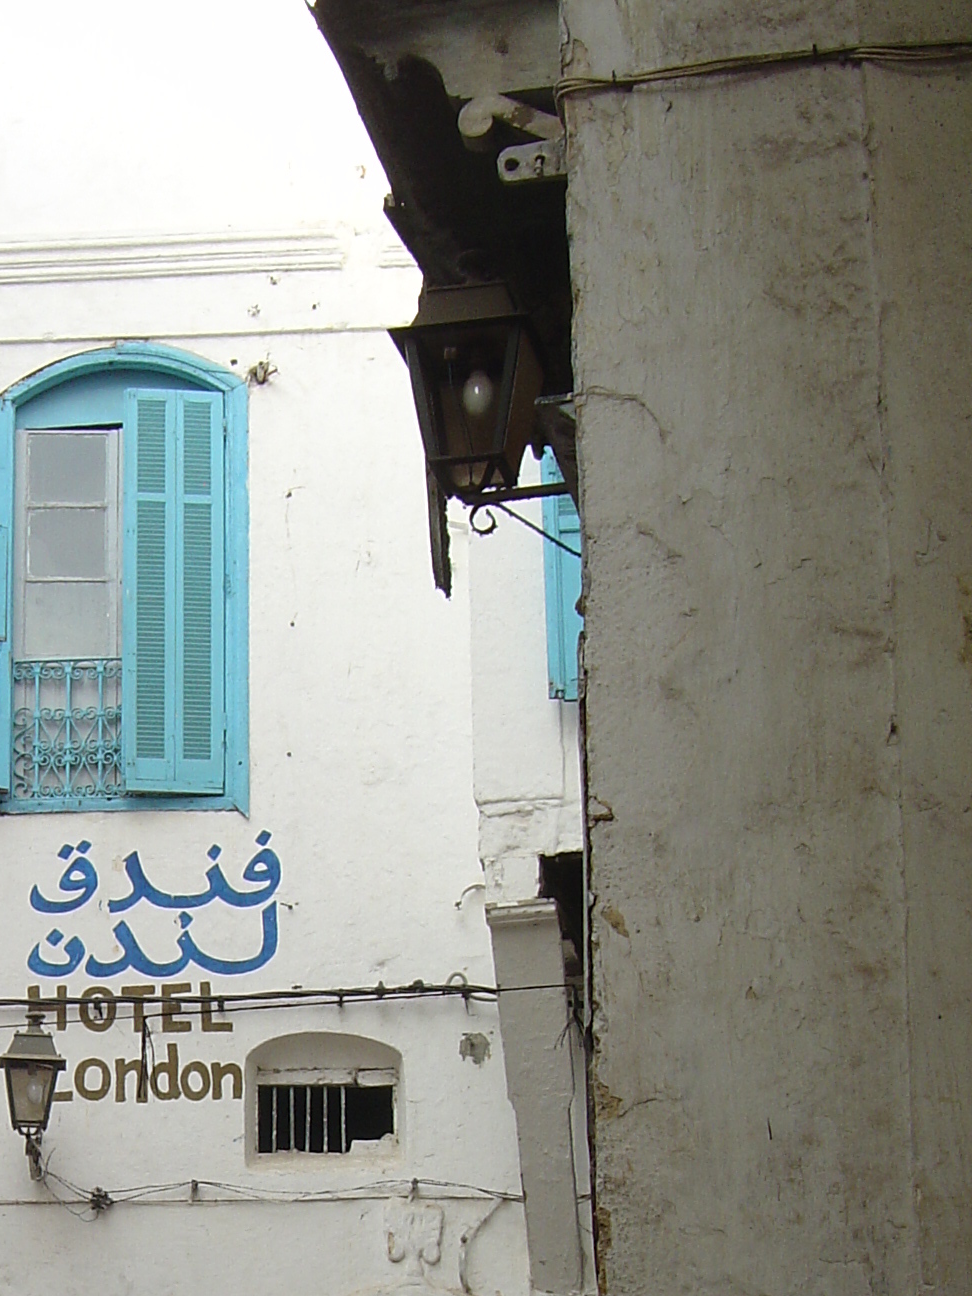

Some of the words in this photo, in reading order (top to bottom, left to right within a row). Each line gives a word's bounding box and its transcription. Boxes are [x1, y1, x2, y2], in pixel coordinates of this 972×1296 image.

[30, 829, 282, 913] فندق
[27, 900, 279, 978] لندن
[27, 981, 234, 1033] HOTEL
